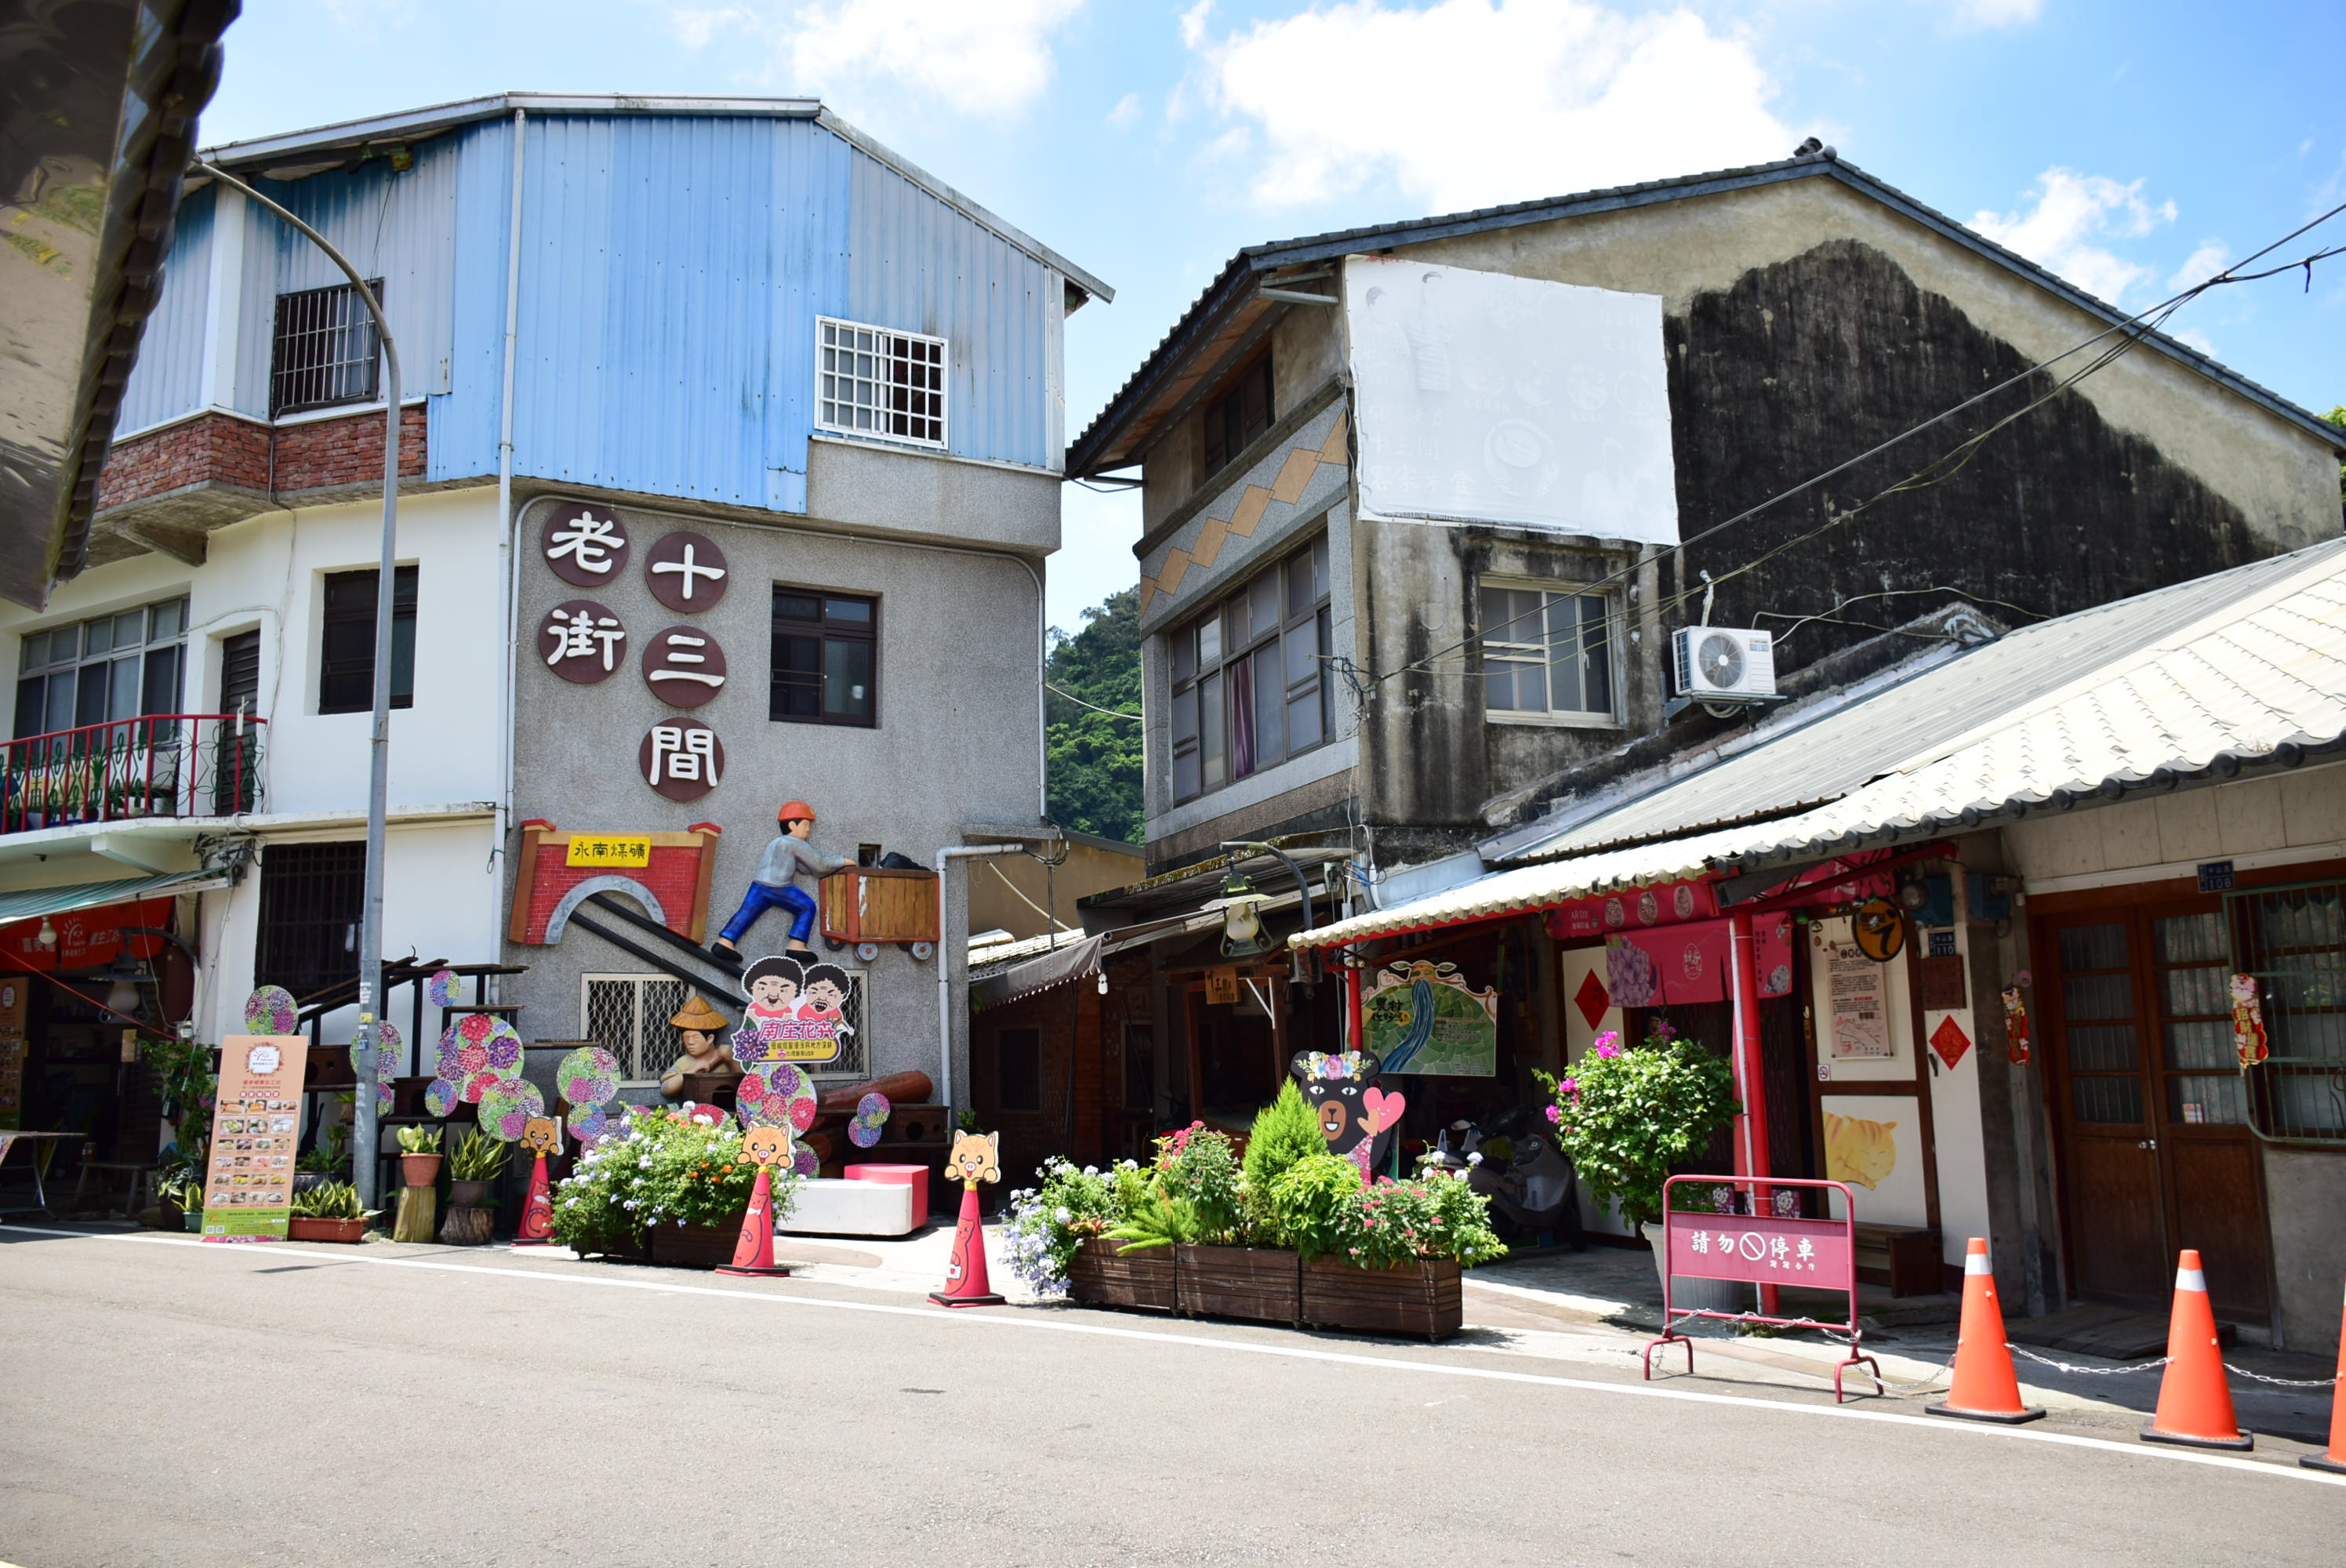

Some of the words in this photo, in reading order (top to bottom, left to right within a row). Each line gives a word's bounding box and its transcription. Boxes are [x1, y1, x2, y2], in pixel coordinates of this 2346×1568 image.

[547, 510, 626, 672] 老街
[649, 543, 726, 787] 十三間
[574, 841, 646, 860] 永南煤礦
[2209, 877, 2232, 890] 108
[1937, 943, 1954, 956] 110
[758, 1020, 836, 1041] 南庄花卉
[1690, 1230, 1734, 1254] 請勿
[1769, 1237, 1816, 1262] 停車
[1769, 1259, 1816, 1272] 謝謝合作
